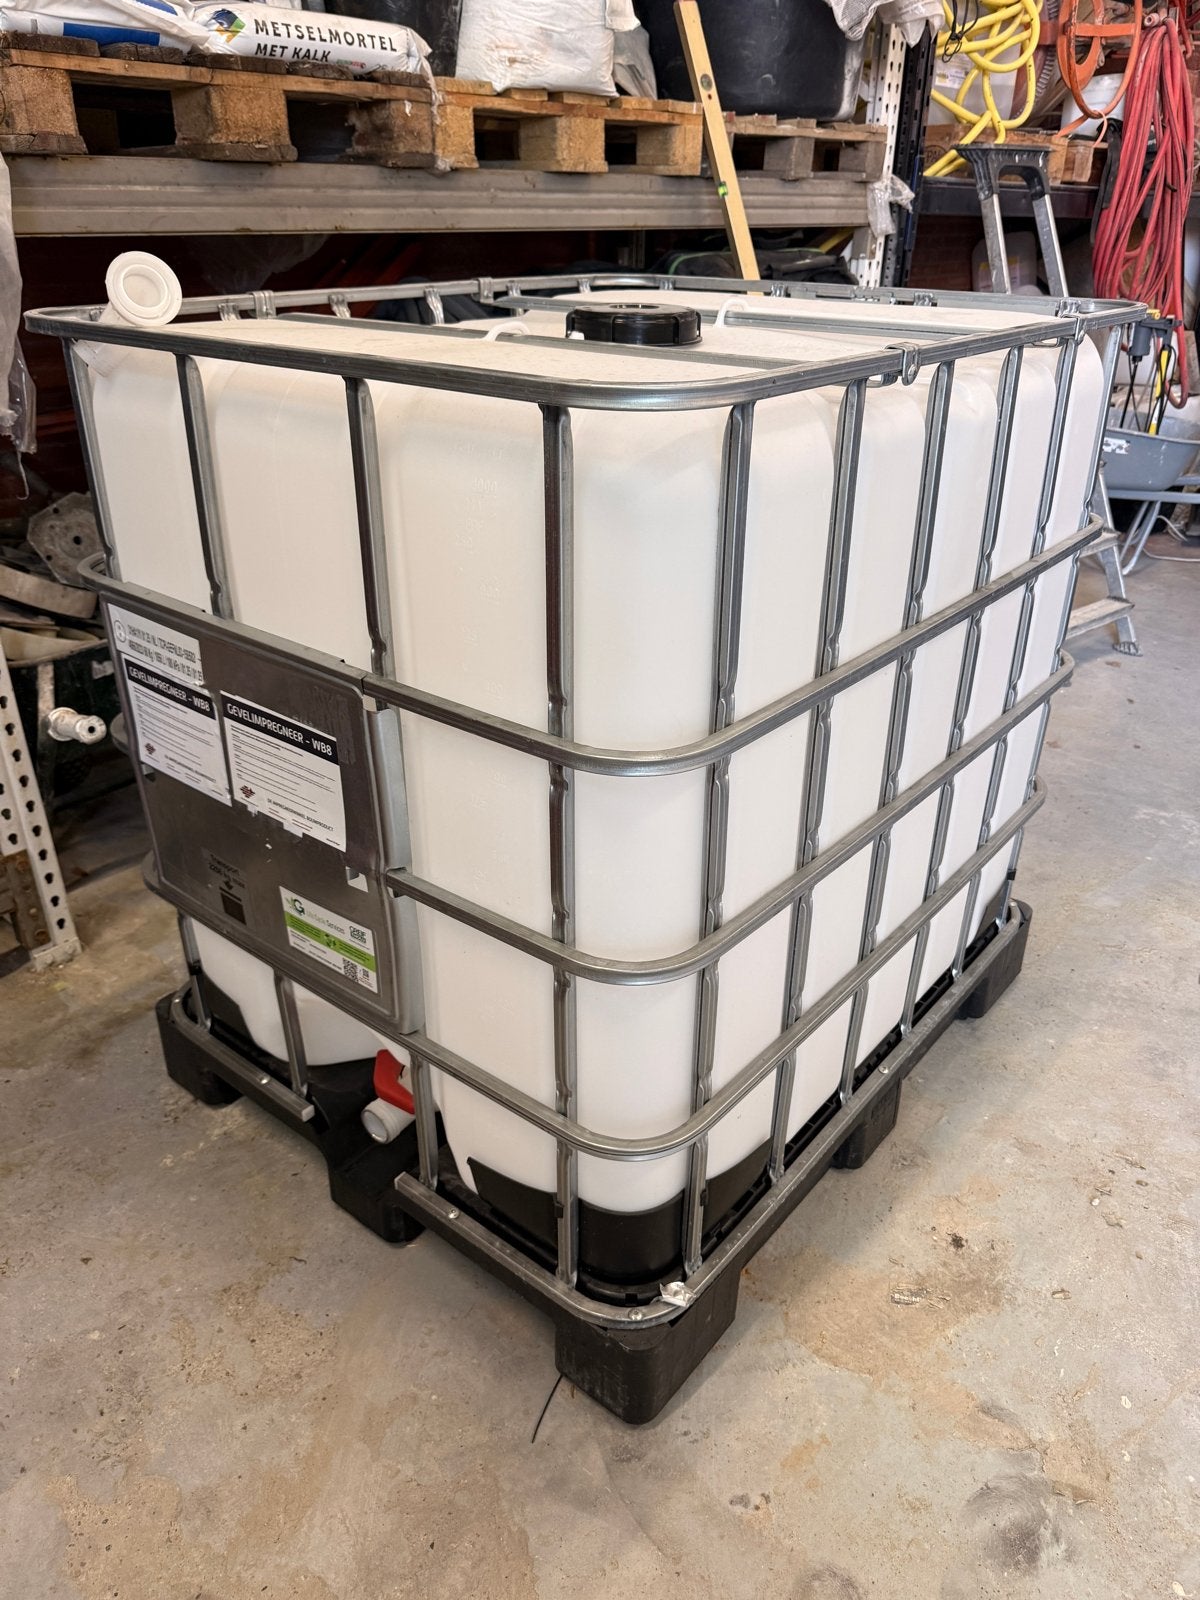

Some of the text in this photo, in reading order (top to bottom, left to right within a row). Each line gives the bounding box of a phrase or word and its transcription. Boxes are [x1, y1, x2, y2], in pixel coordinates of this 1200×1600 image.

[254, 18, 397, 52] METSELMORTEL
[255, 43, 331, 62] MET KALK
[193, 696, 211, 712] WB8
[227, 703, 304, 744] GEVELIMPREGNEER
[312, 738, 333, 756] WB8
